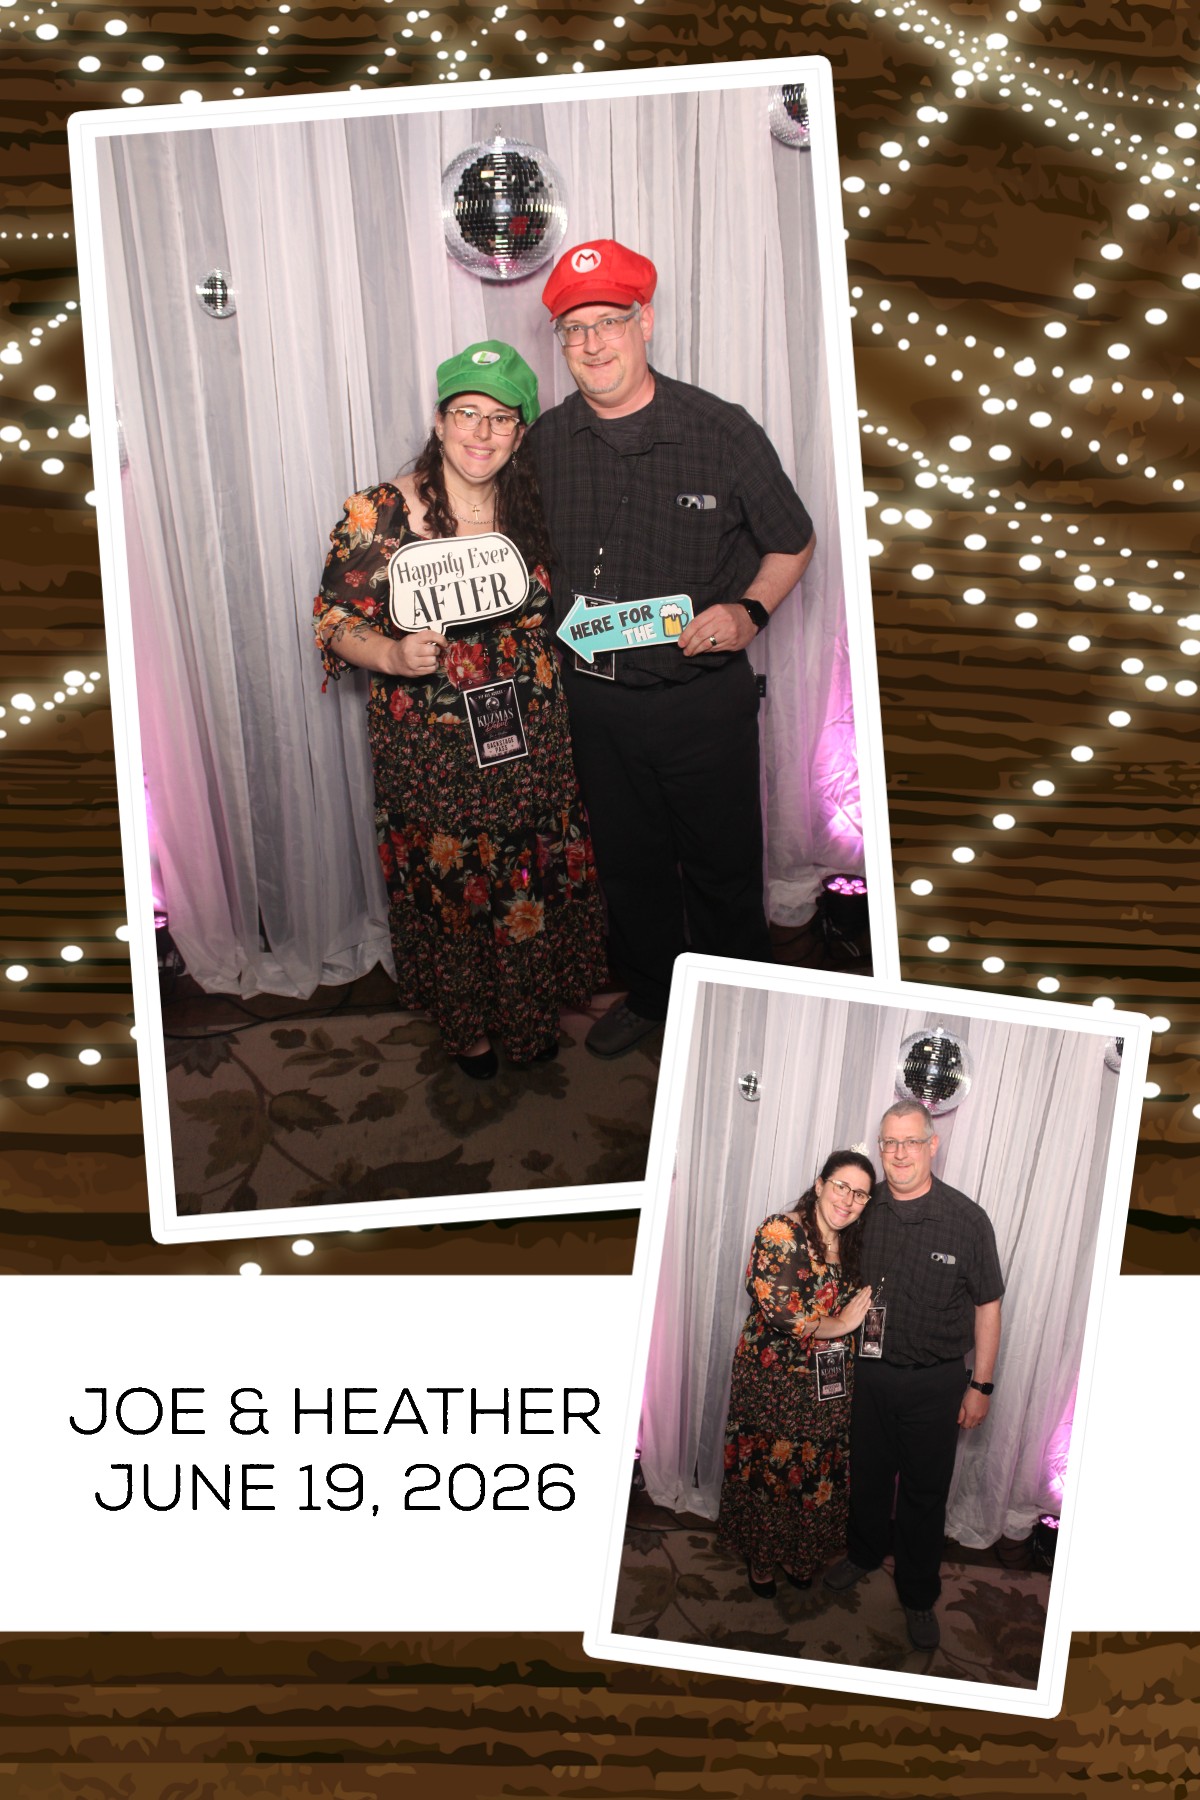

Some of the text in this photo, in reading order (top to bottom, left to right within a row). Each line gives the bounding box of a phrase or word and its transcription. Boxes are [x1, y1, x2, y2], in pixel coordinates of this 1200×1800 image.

[575, 252, 599, 268] M
[477, 352, 491, 364] L
[396, 546, 510, 587] Happily Ever
[412, 572, 514, 625] AFTER
[570, 605, 654, 641] HERE FOR
[621, 622, 657, 645] THE
[477, 708, 514, 728] KUZMAS
[486, 737, 515, 750] BACKSTAGE
[494, 745, 508, 754] PASS
